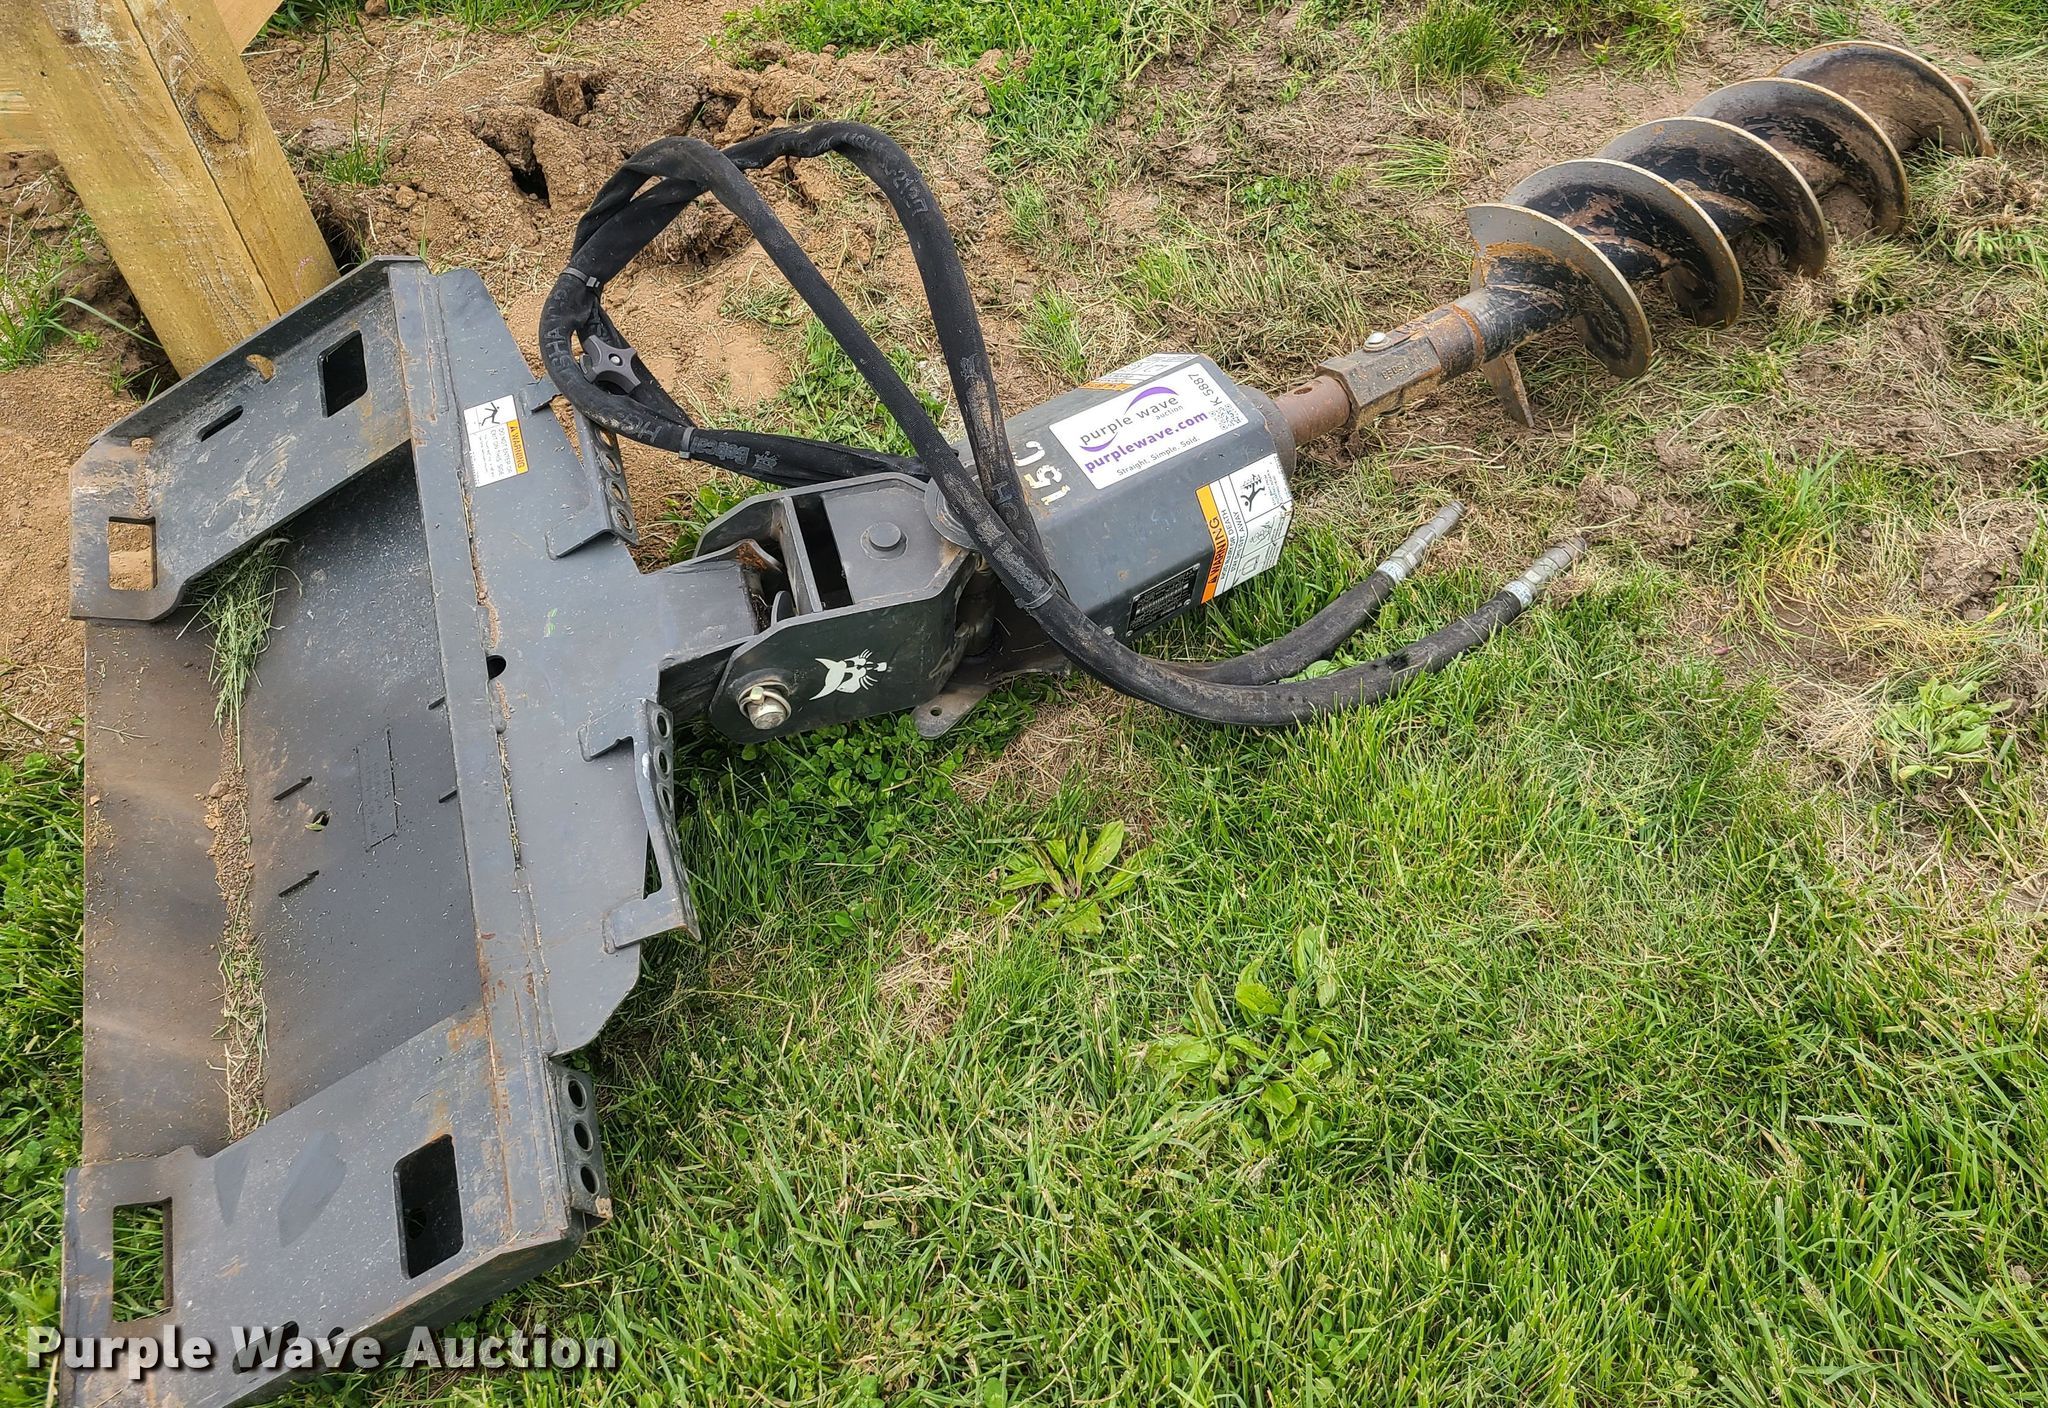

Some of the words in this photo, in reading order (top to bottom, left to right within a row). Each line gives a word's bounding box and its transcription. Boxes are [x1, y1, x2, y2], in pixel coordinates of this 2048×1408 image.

[1187, 373, 1214, 397] 5887
[1155, 405, 1183, 420] auction
[1210, 397, 1222, 407] K
[1080, 417, 1133, 446] purple
[1136, 397, 1179, 419] wave
[512, 432, 525, 468] WARNING
[1085, 412, 1208, 474] purplewave.com
[1116, 459, 1150, 476] Straight.
[1150, 445, 1180, 462] Simple.
[1180, 436, 1200, 447] Sold.
[1221, 509, 1234, 535] DEATH
[1233, 511, 1245, 532] AWAY
[1209, 516, 1226, 577] WARNING
